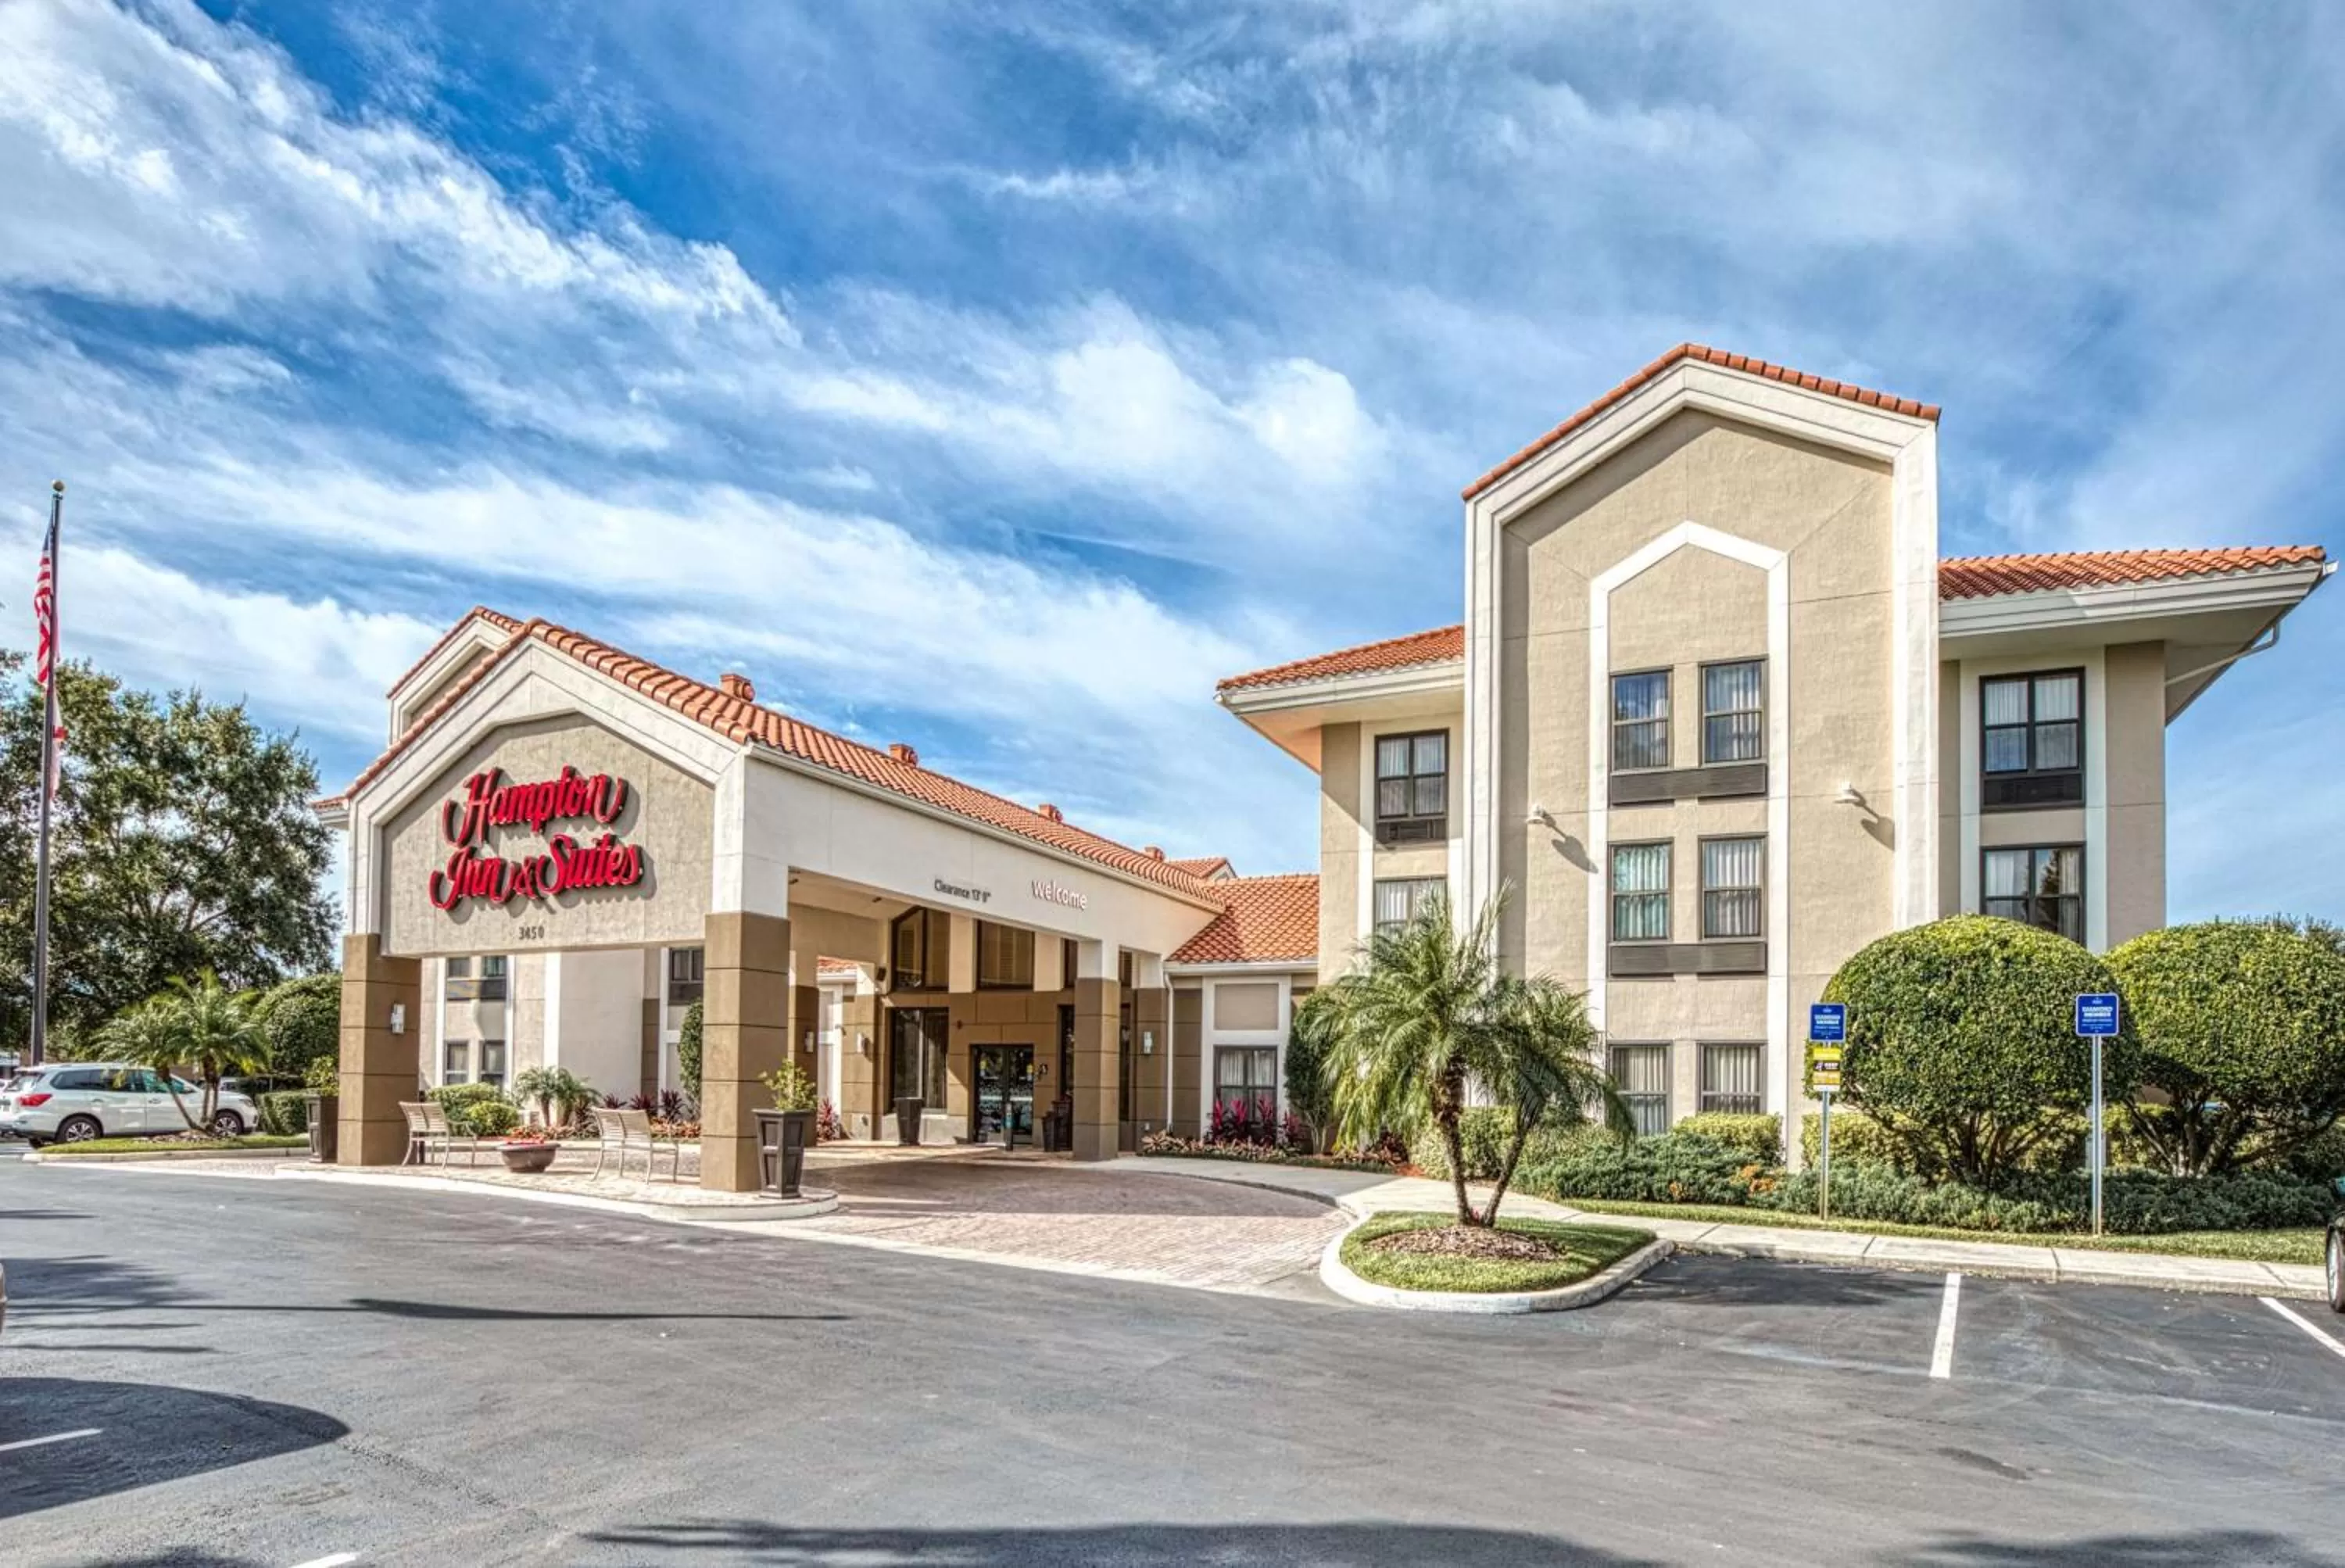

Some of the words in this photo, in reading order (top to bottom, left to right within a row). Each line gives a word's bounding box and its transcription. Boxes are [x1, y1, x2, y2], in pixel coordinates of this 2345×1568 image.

[442, 763, 628, 849] Hampton
[428, 846, 514, 910] Inn
[514, 856, 539, 900] &
[536, 832, 644, 894] Suites
[1031, 879, 1089, 911] Welcome
[518, 925, 545, 940] 3450
